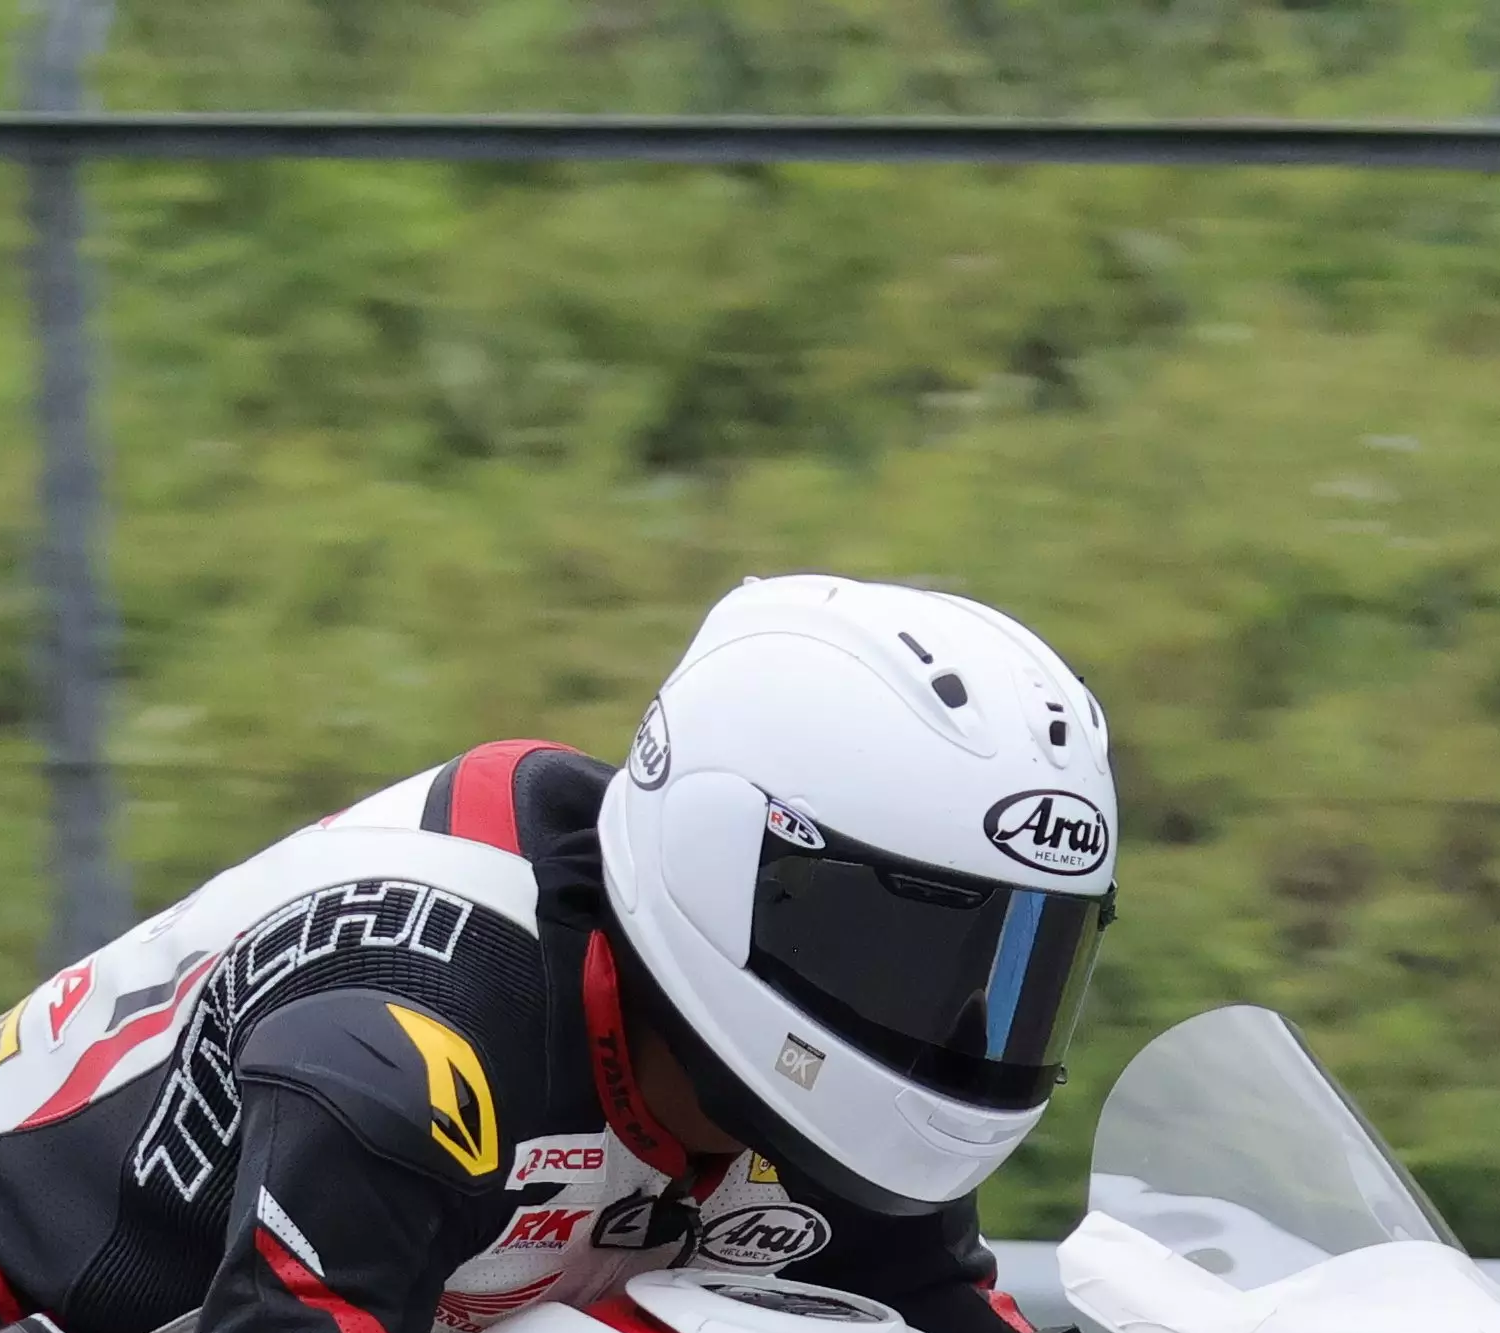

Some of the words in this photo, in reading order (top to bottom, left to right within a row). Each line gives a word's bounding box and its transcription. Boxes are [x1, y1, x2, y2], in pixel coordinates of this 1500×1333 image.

[994, 796, 1102, 856] Arai
[1034, 850, 1082, 866] HELMET
[544, 1148, 605, 1170] RCB
[500, 1209, 595, 1248] RK
[701, 1212, 816, 1254] Arai
[720, 1247, 767, 1261] HELMET
